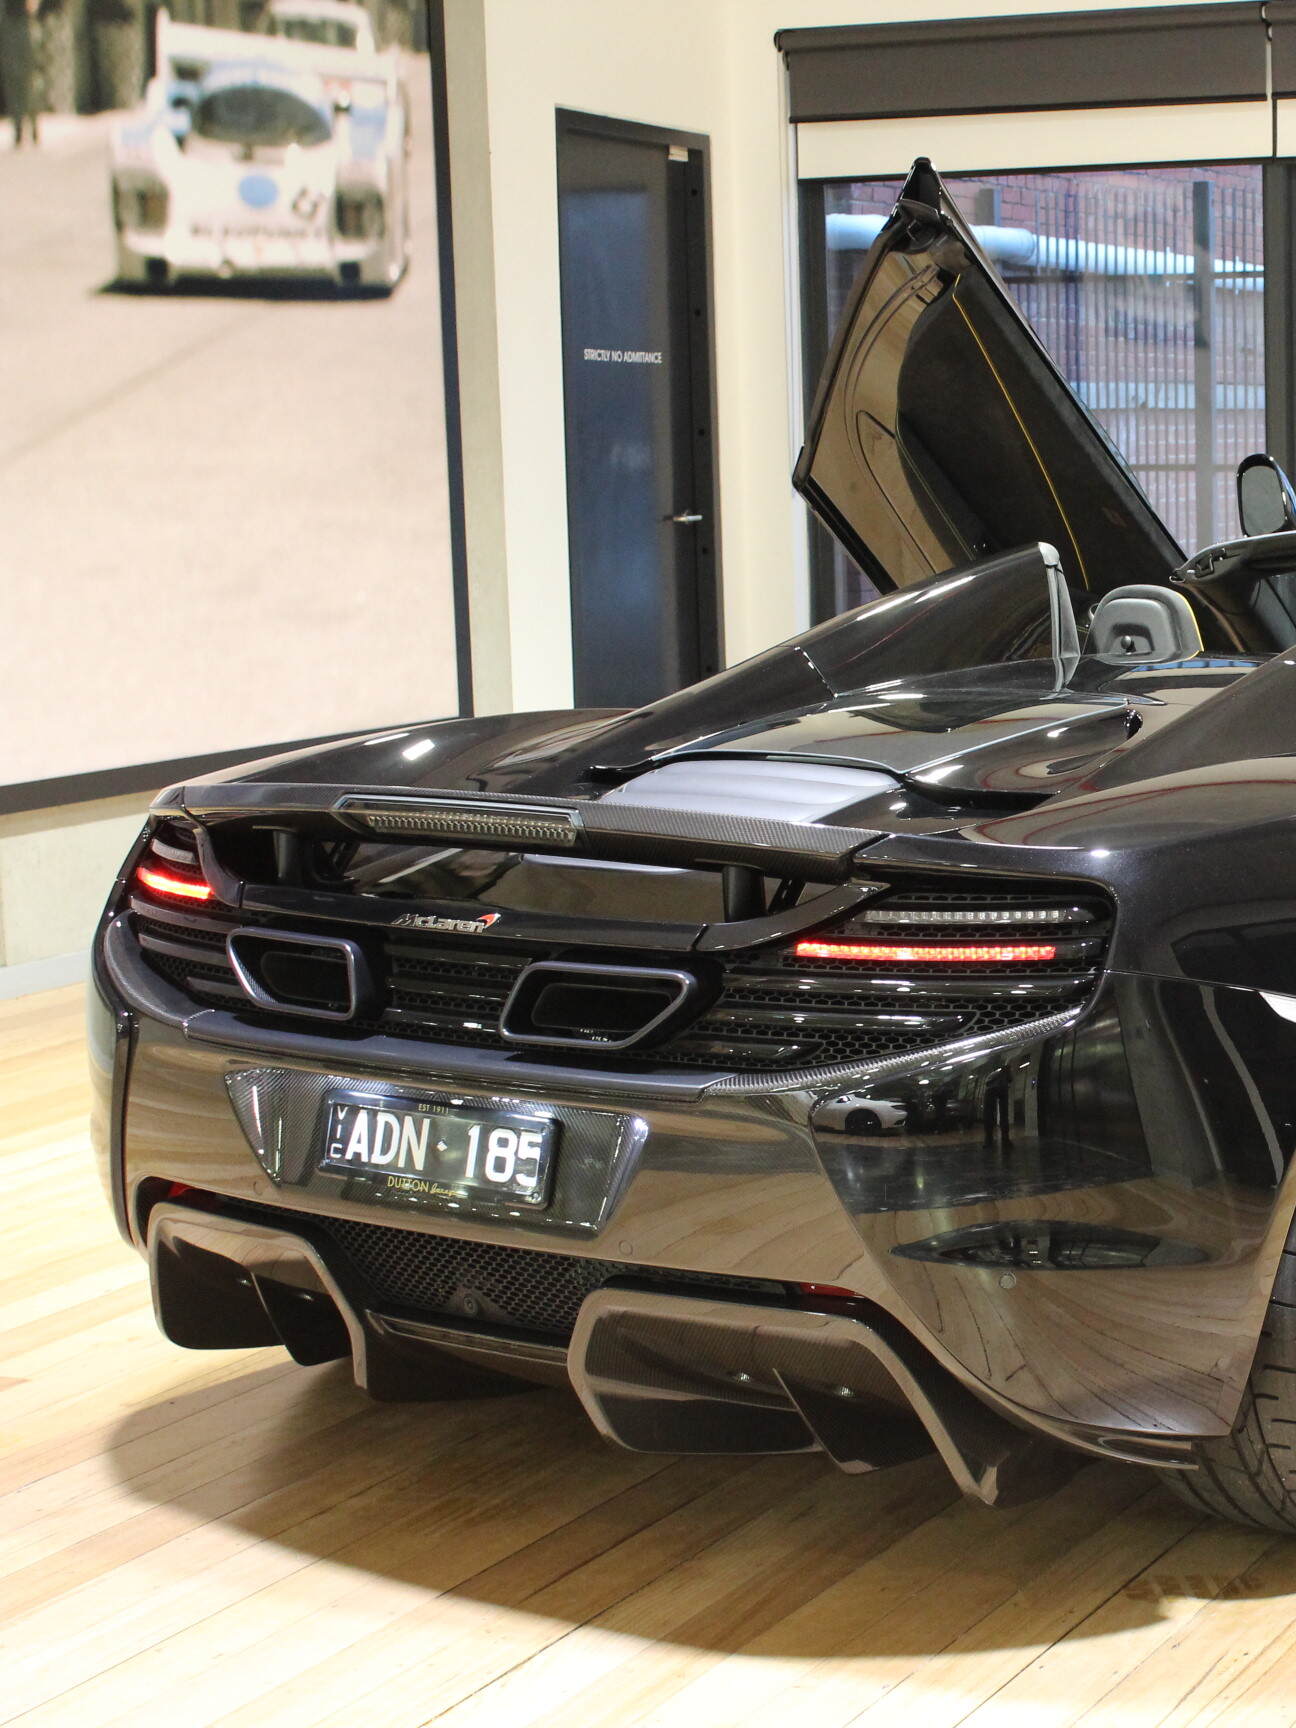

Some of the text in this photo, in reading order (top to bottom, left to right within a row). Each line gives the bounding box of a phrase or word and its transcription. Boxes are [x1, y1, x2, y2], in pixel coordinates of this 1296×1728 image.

[583, 348, 663, 363] STRICTLY NO ADMITTANCE
[391, 913, 486, 933] McLaren
[418, 1103, 449, 1115] EST 1911
[330, 1105, 349, 1160] VIC
[345, 1109, 543, 1188] ADN 185
[387, 1176, 430, 1194] DUTTON
